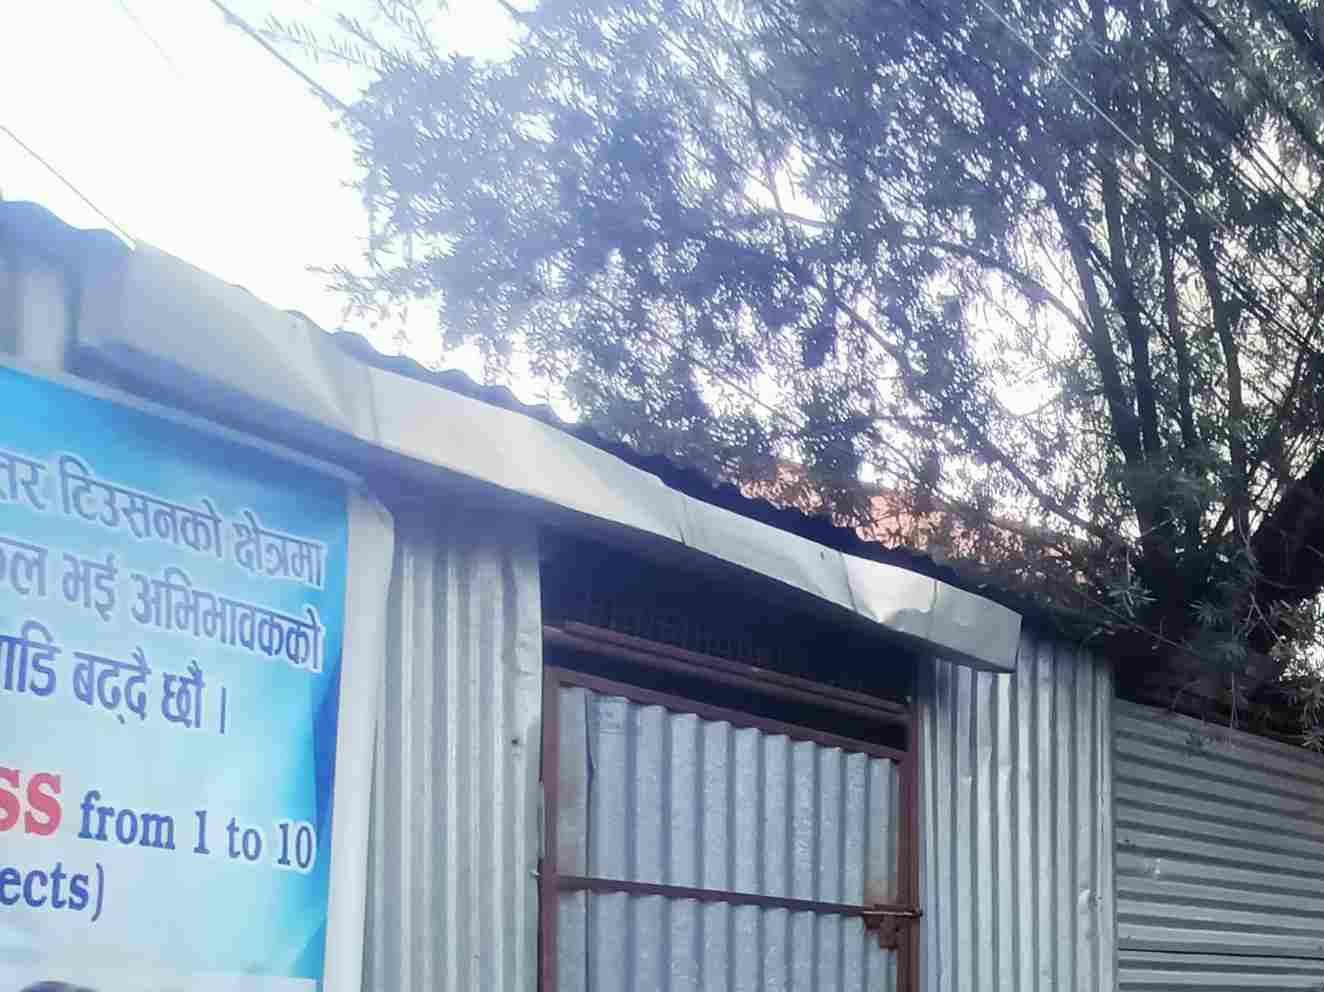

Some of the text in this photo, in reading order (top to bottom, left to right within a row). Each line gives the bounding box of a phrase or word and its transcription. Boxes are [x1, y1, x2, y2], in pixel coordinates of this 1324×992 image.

[59, 455, 222, 558] टिउसनको
[232, 510, 323, 586] क्षेत्रमा
[63, 552, 118, 622] भई
[130, 567, 321, 669] अभिभावकको
[77, 790, 176, 850] from
[193, 810, 211, 855] 1
[226, 817, 262, 862] to
[277, 823, 314, 869] 10
